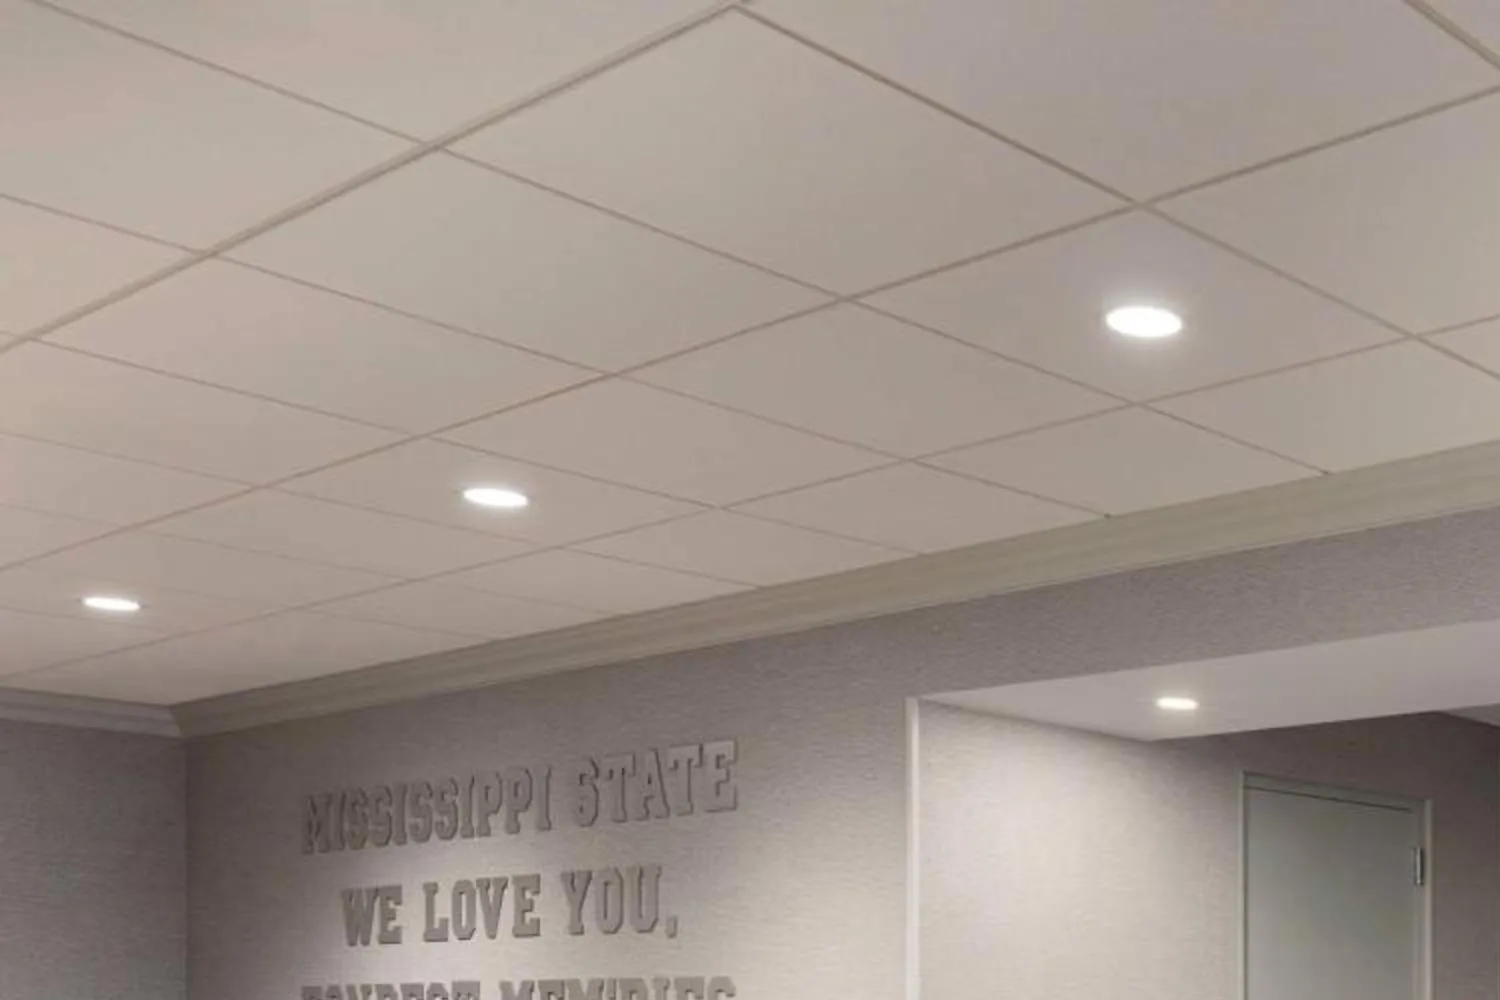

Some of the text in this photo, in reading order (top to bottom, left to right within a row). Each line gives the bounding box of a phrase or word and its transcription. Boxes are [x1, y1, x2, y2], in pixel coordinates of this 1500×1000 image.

[302, 740, 738, 855] MISSISSIPPI STATE
[341, 865, 678, 946] WE LOVE YOU,
